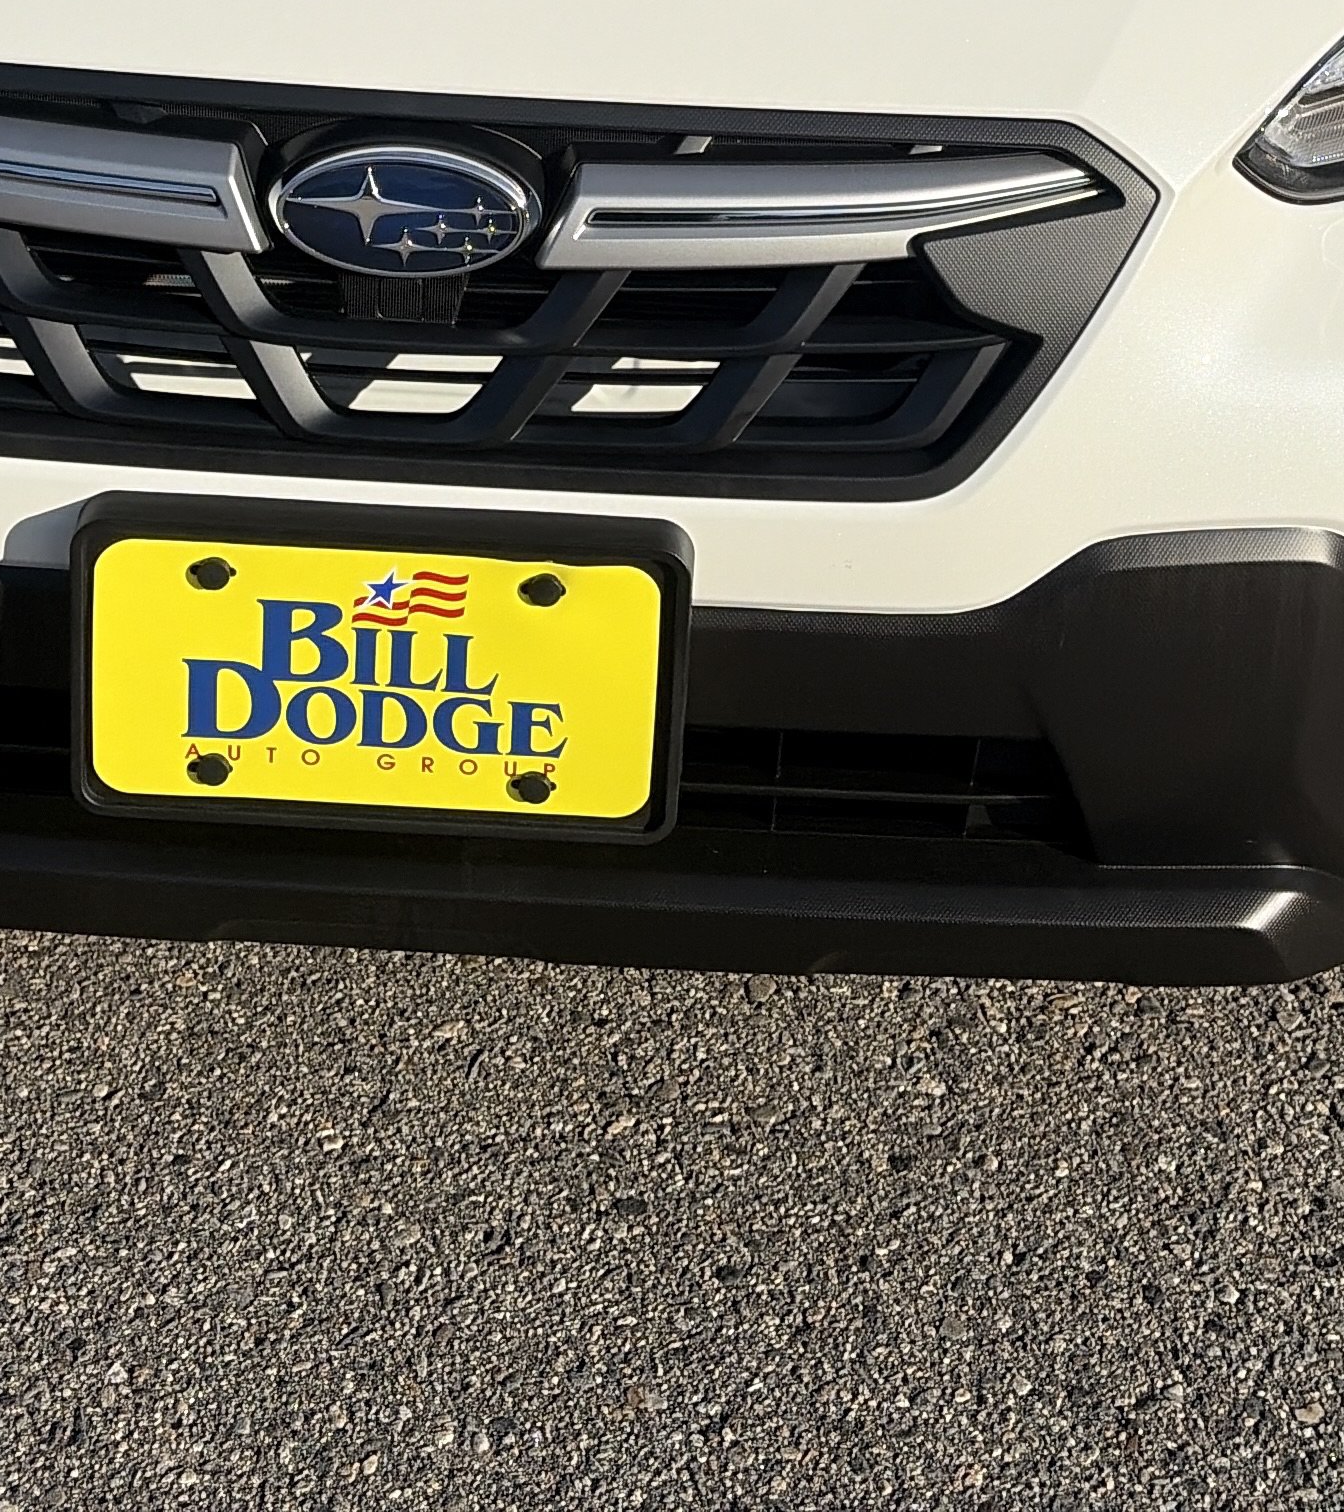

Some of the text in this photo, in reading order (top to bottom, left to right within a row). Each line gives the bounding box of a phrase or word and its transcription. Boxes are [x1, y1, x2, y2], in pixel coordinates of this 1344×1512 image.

[256, 599, 499, 696] BILL
[181, 658, 568, 758] DODGE
[185, 743, 556, 777] AUTO GROUP
